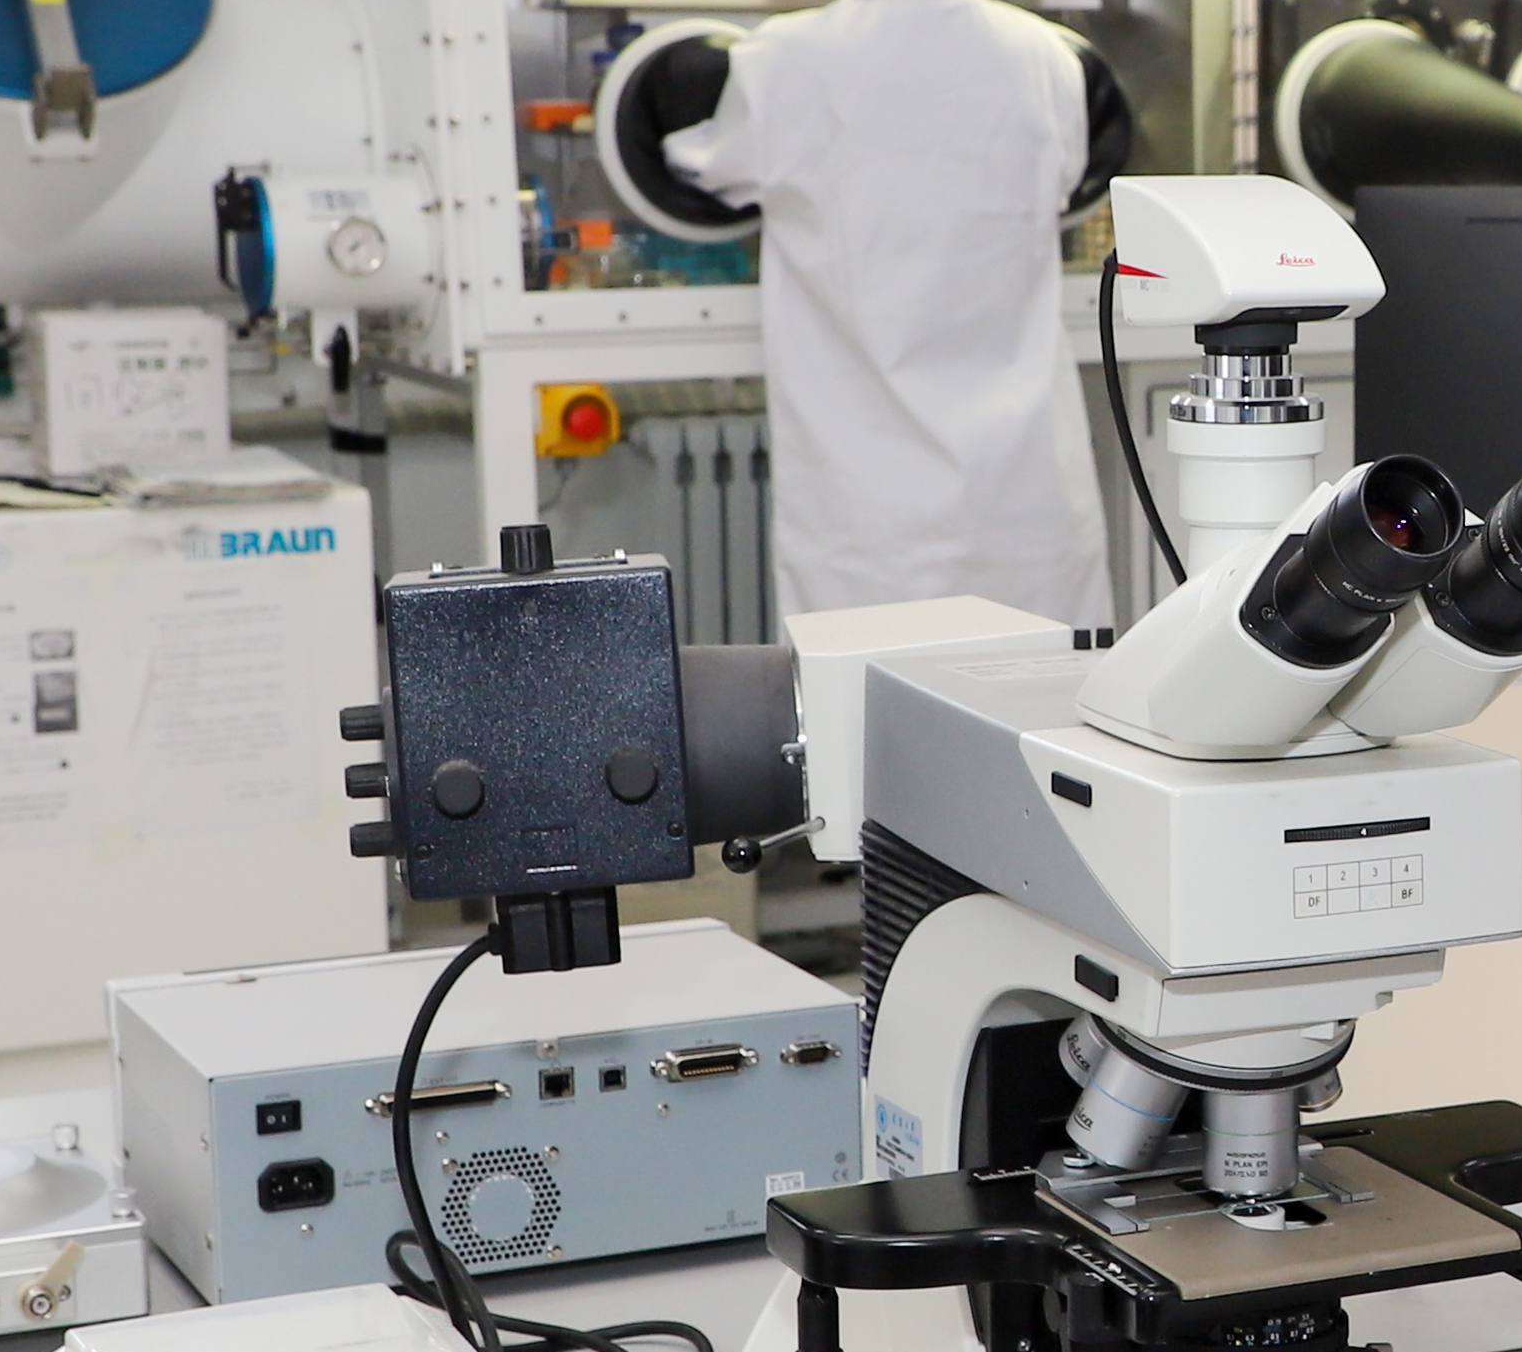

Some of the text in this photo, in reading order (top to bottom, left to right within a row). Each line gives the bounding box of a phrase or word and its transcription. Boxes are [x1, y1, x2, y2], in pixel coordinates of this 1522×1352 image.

[1277, 253, 1316, 267] Leica
[1340, 870, 1346, 881] 2
[1372, 867, 1378, 877] 3
[1403, 863, 1409, 873] 4
[1308, 888, 1414, 907] DF BF
